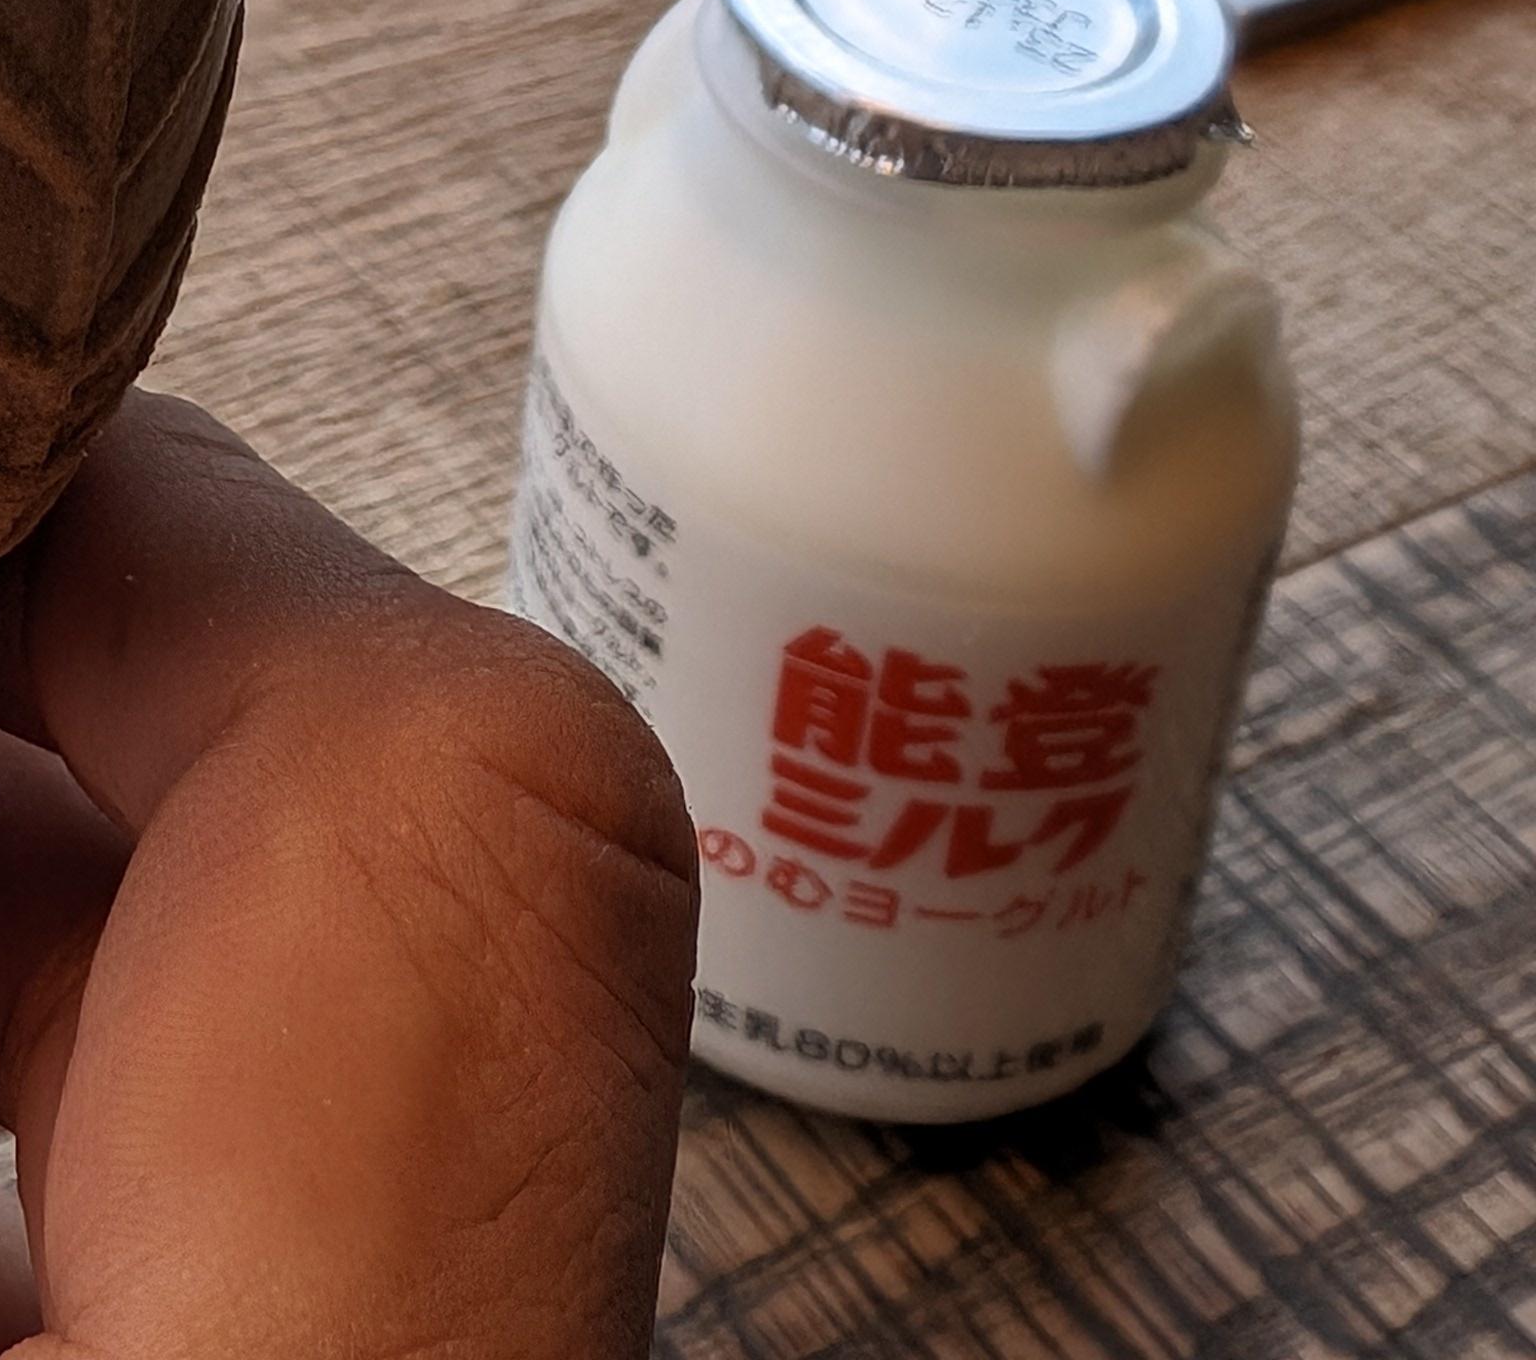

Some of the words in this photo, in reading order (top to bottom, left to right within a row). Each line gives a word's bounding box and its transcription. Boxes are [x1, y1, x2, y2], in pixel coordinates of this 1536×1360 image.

[772, 624, 1161, 792] 能登
[760, 752, 1136, 879] ミルク
[699, 827, 1147, 939] のむヨーグルト
